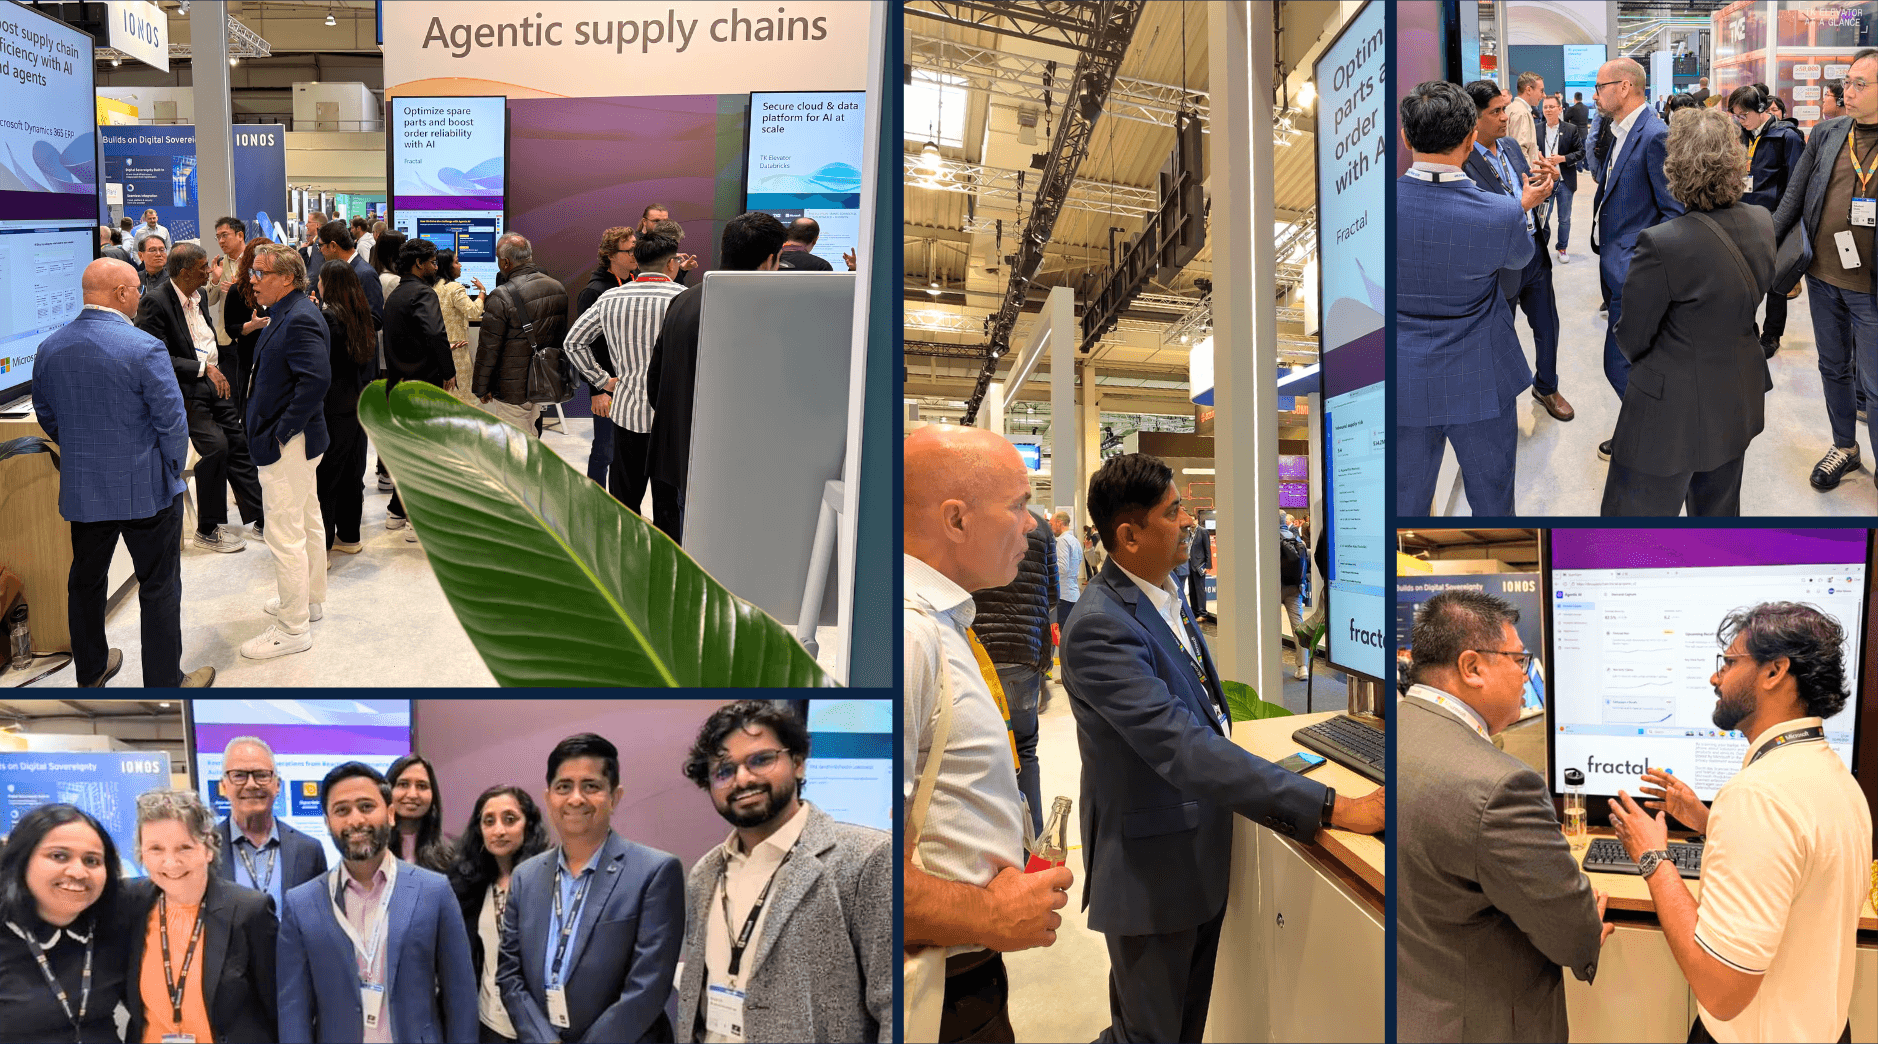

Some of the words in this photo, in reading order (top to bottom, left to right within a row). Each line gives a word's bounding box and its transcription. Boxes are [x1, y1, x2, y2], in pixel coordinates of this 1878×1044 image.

[123, 8, 160, 48] IONOS
[1828, 18, 1861, 26] GLANCE
[422, 12, 562, 58] Agentic
[574, 9, 698, 54] supply
[710, 6, 827, 42] chains
[22, 28, 54, 50] supply
[56, 40, 79, 60] chain
[1334, 20, 1385, 92] Optim
[41, 55, 61, 72] with
[64, 60, 73, 76] AI
[13, 66, 46, 86] agents
[763, 102, 794, 110] Secure
[797, 102, 824, 110] cloud
[826, 102, 834, 110] &
[838, 102, 859, 110] data
[1334, 75, 1374, 135] parts
[404, 107, 444, 117] Optimize
[447, 108, 471, 117] spare
[762, 113, 803, 124] platform
[806, 113, 819, 121] for
[404, 119, 426, 128] parts
[429, 118, 445, 126] and
[448, 118, 474, 126] boost
[762, 125, 785, 133] scale
[25, 121, 52, 135] Dynamics
[53, 127, 64, 138] 365
[65, 129, 74, 139] ERP
[404, 129, 428, 137] order
[430, 129, 472, 139] reliability
[1335, 108, 1378, 161] order
[102, 136, 126, 144] Builds
[140, 136, 164, 145] Digital
[166, 136, 196, 144] Soverei
[236, 134, 275, 146] IONOS
[404, 140, 423, 148] with
[1335, 152, 1370, 196] with
[1336, 210, 1368, 245] Fractal
[1424, 584, 1444, 592] Digital
[1502, 581, 1536, 592] IONOS
[1785, 731, 1809, 740] Microsoft
[121, 760, 160, 774] IONOS
[1587, 755, 1649, 775] fractal
